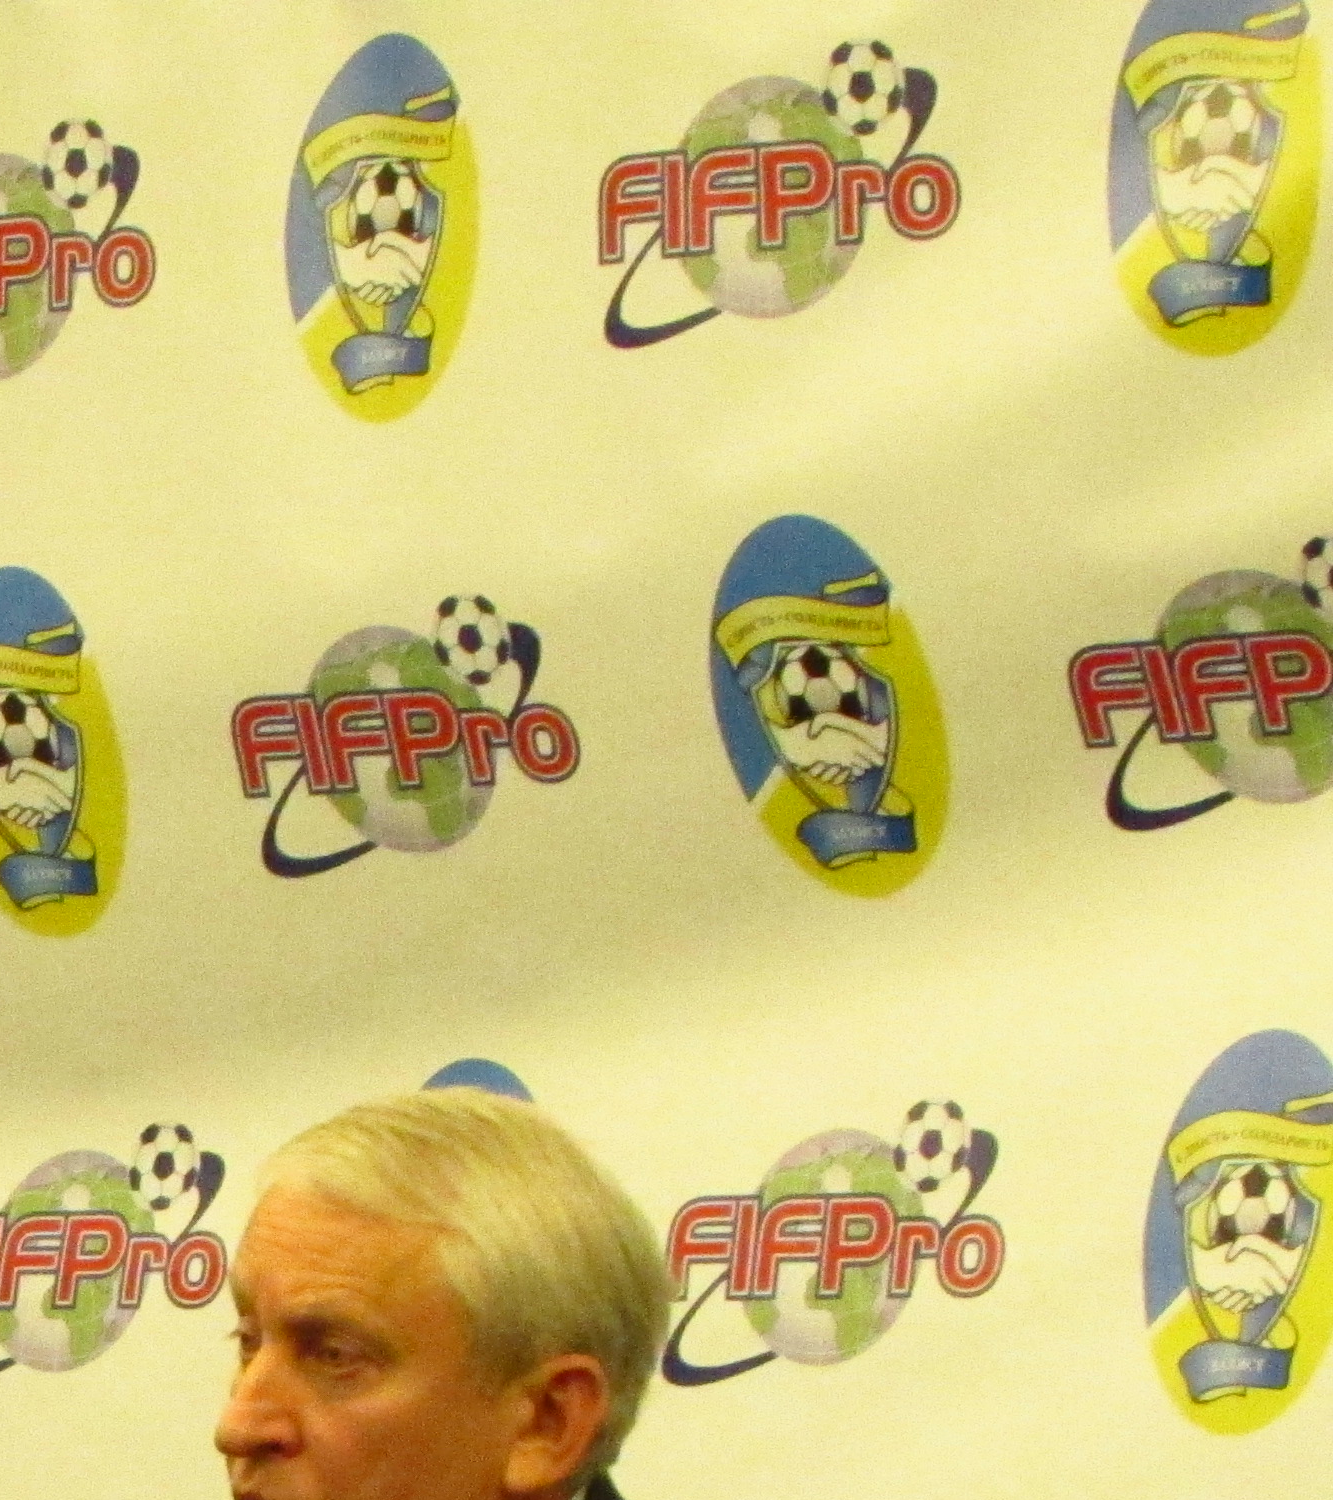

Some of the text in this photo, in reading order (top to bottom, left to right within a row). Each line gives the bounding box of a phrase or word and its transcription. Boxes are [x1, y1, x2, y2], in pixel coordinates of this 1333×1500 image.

[599, 141, 959, 262] FIFPro
[231, 688, 578, 796] FIFPro
[1067, 630, 1333, 748] FIFP
[666, 1193, 1005, 1301] FIFPro
